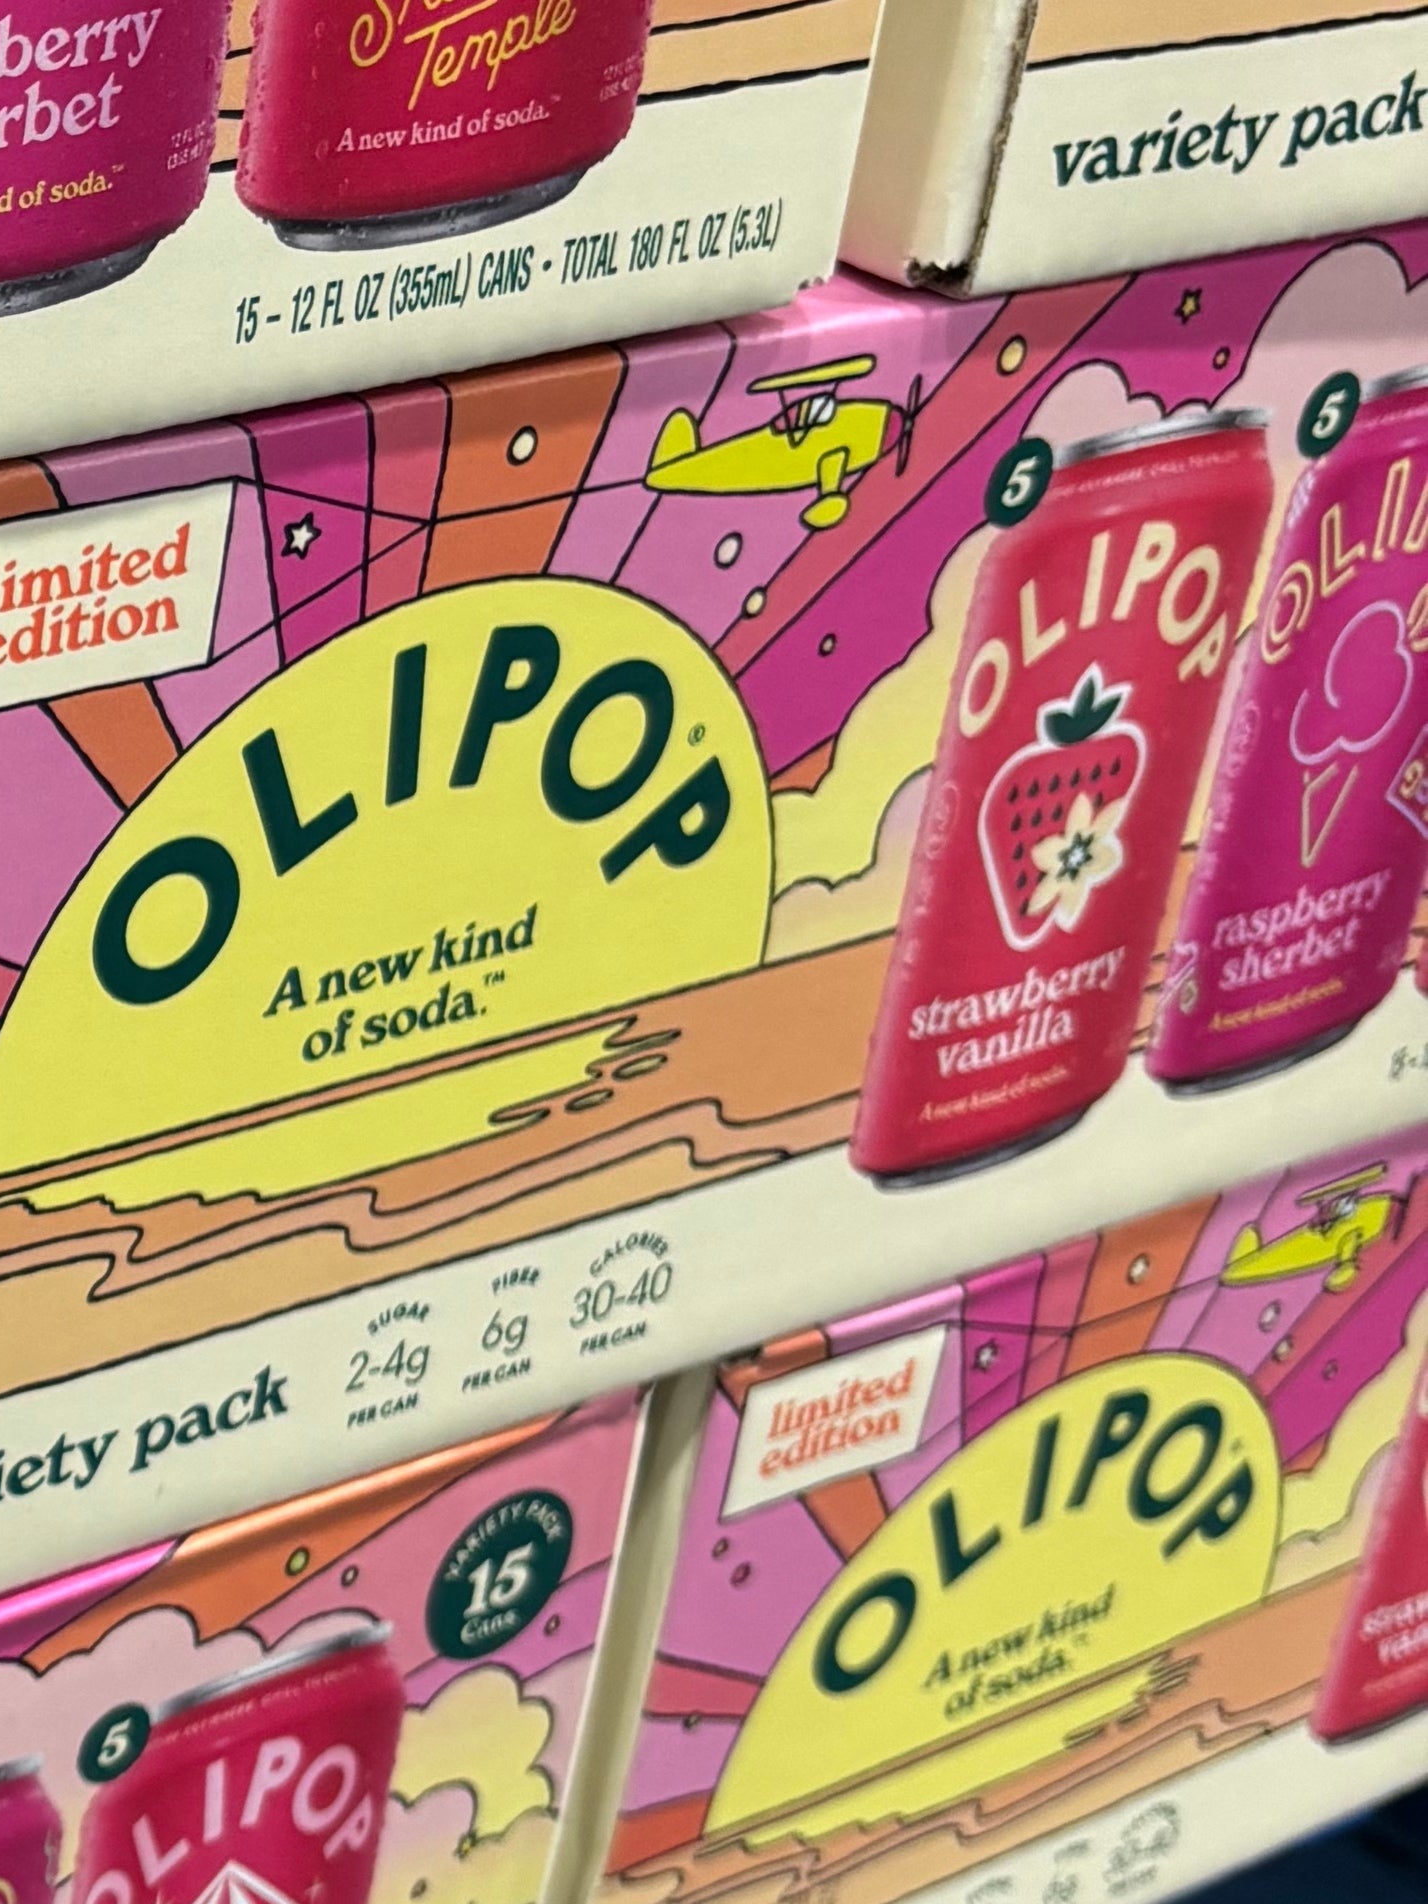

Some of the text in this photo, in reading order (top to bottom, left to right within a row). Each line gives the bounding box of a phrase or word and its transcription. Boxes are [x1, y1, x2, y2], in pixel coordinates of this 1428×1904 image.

[1053, 70, 1428, 187] variety pack
[235, 197, 784, 345] 15 12 FL OZ (355mL) CANS TOTAL 180 FL OZ (5.3L)
[1001, 458, 1037, 508] 5
[959, 521, 1229, 738] OLIPOP
[92, 624, 731, 1005] OLIPOP
[262, 903, 538, 1017] A new kind
[908, 944, 1125, 1038] strawberry
[301, 1013, 353, 1063] of
[937, 1006, 1073, 1078] vanilla
[569, 1263, 675, 1331] 30-40
[345, 1338, 430, 1393] 2-4g
[767, 1358, 915, 1444] limited
[129, 1364, 290, 1474] pack
[759, 1410, 901, 1480] edition
[813, 1387, 1255, 1695] OLIPOP
